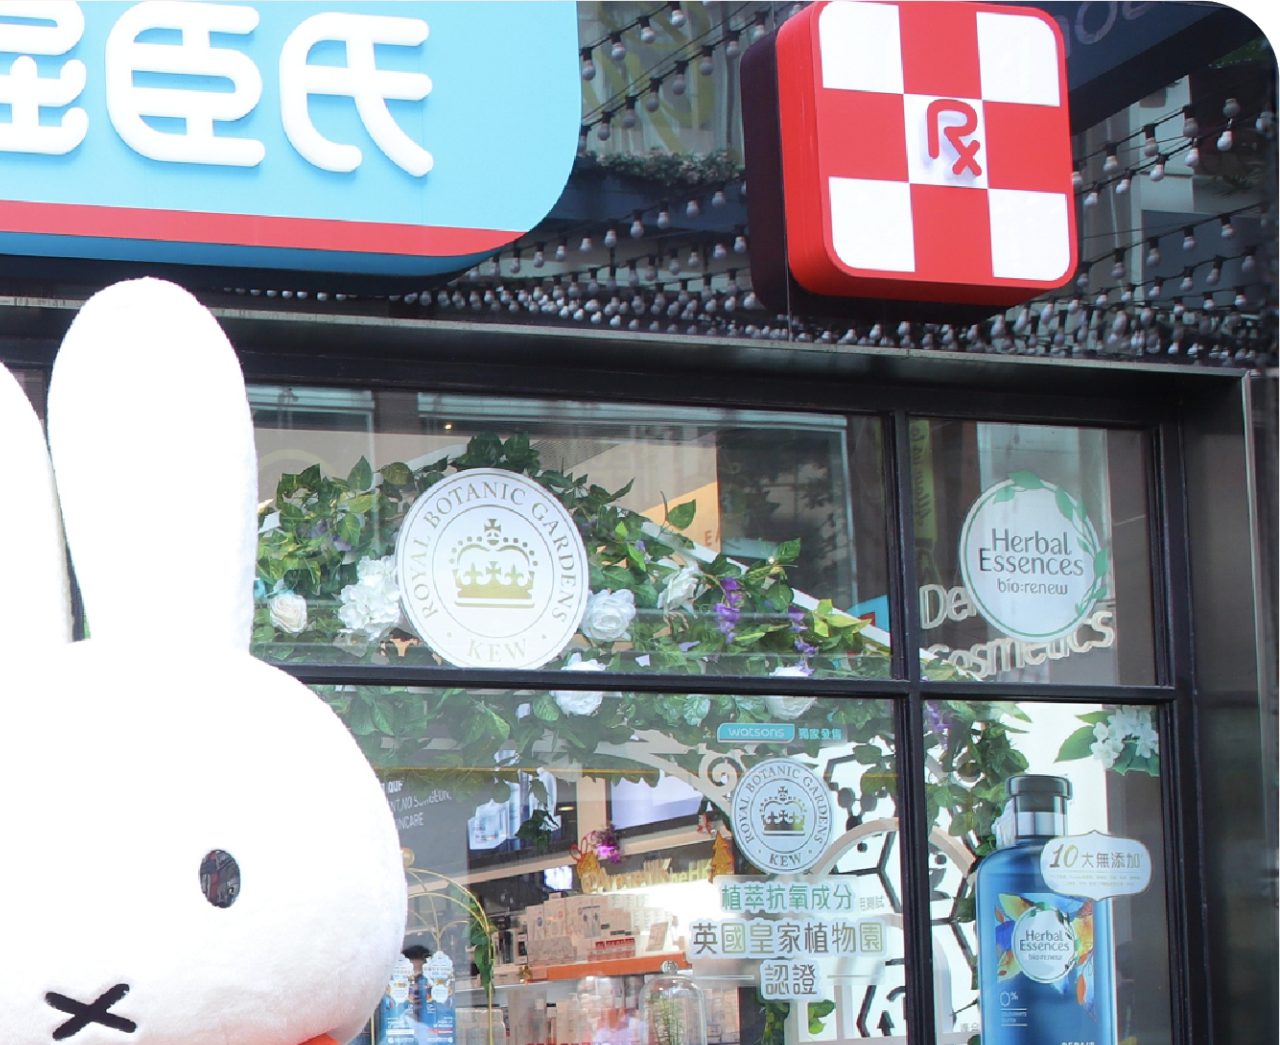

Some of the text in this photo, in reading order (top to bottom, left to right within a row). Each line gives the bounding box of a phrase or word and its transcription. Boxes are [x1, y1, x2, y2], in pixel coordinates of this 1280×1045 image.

[411, 480, 577, 623] ROYAL BOTANIC GARDENS
[991, 528, 1073, 555] Herbal
[979, 547, 1084, 576] Essences
[468, 638, 528, 663] KEW
[728, 727, 785, 738] watsons
[737, 765, 829, 844] ROYAL BOTANIC GARDENS
[769, 852, 802, 866] KEW
[1049, 843, 1141, 869] 10大無添加
[721, 884, 853, 911] 植萃抗氧成分
[692, 922, 885, 954] 英國皇家植物園
[1019, 940, 1070, 951] Essences
[1026, 930, 1064, 942] Herbal
[765, 964, 818, 996] 認證
